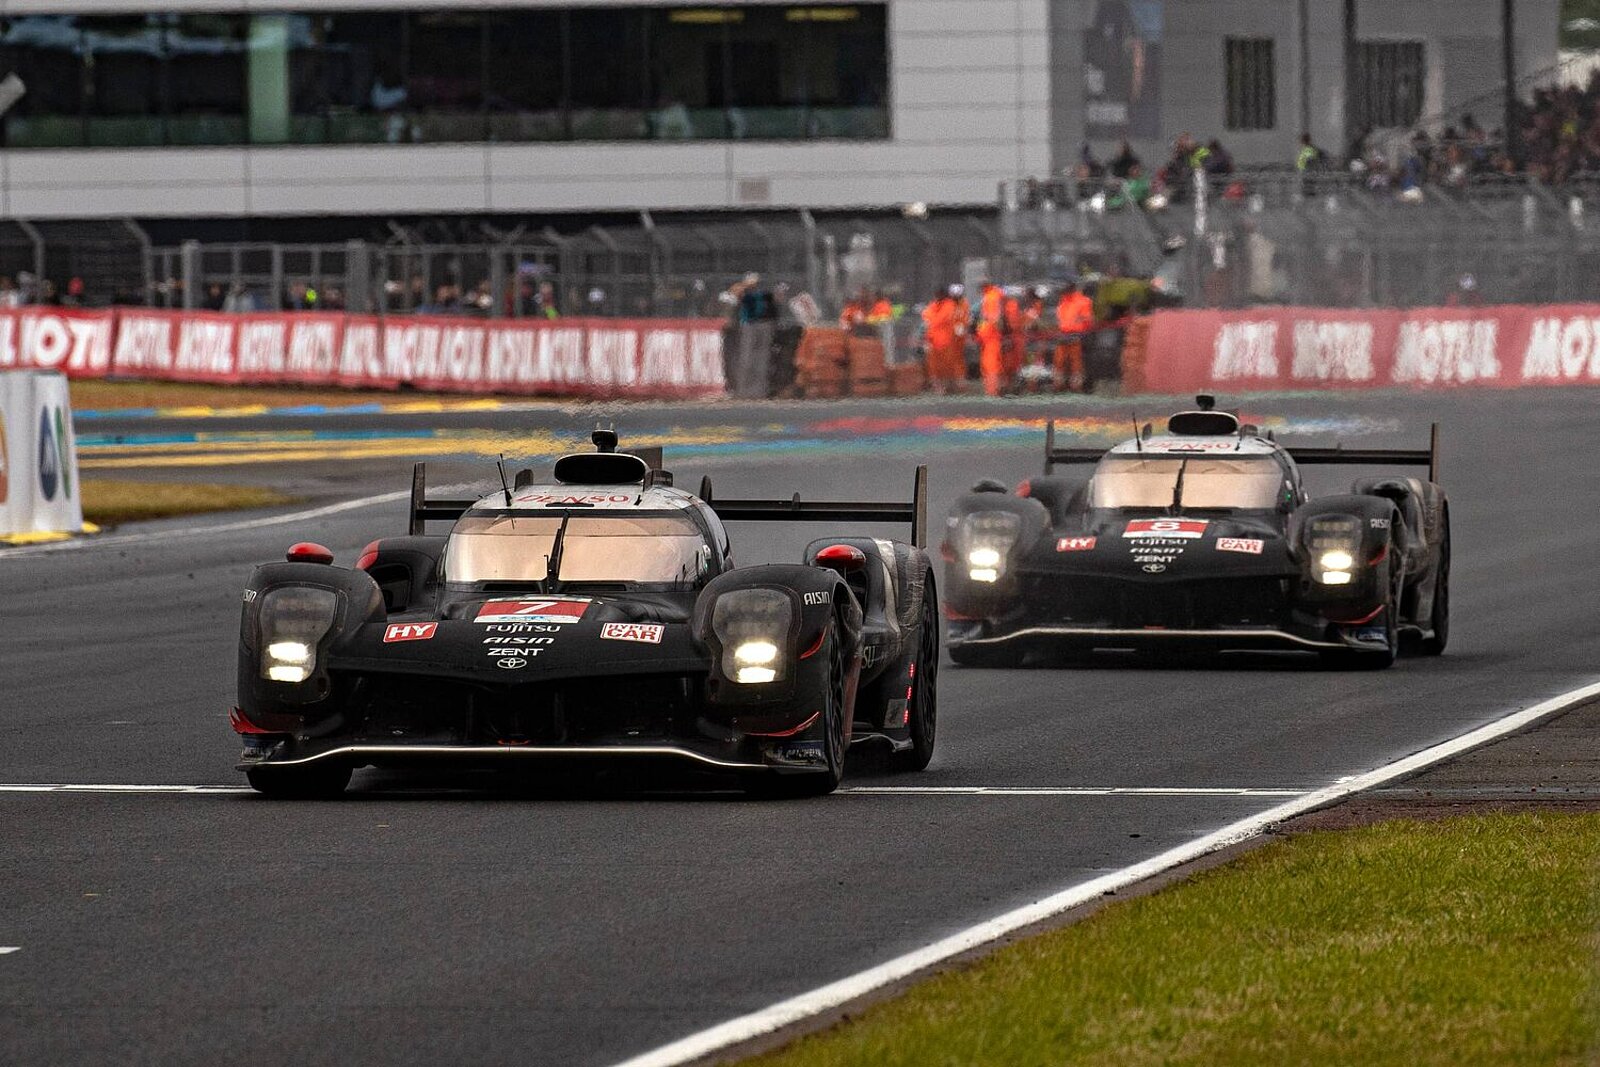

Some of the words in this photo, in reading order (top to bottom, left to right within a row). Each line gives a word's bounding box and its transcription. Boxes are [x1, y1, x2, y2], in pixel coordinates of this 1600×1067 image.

[516, 494, 630, 504] DENSO
[1150, 521, 1180, 531] 8
[1060, 538, 1092, 551] HY
[1221, 542, 1258, 551] CAR
[1133, 555, 1177, 563] ZENT
[513, 602, 559, 614] 7
[388, 624, 432, 639] HY
[486, 622, 561, 634] FUJITSU
[607, 629, 656, 641] CAR
[487, 648, 544, 656] ZENT
